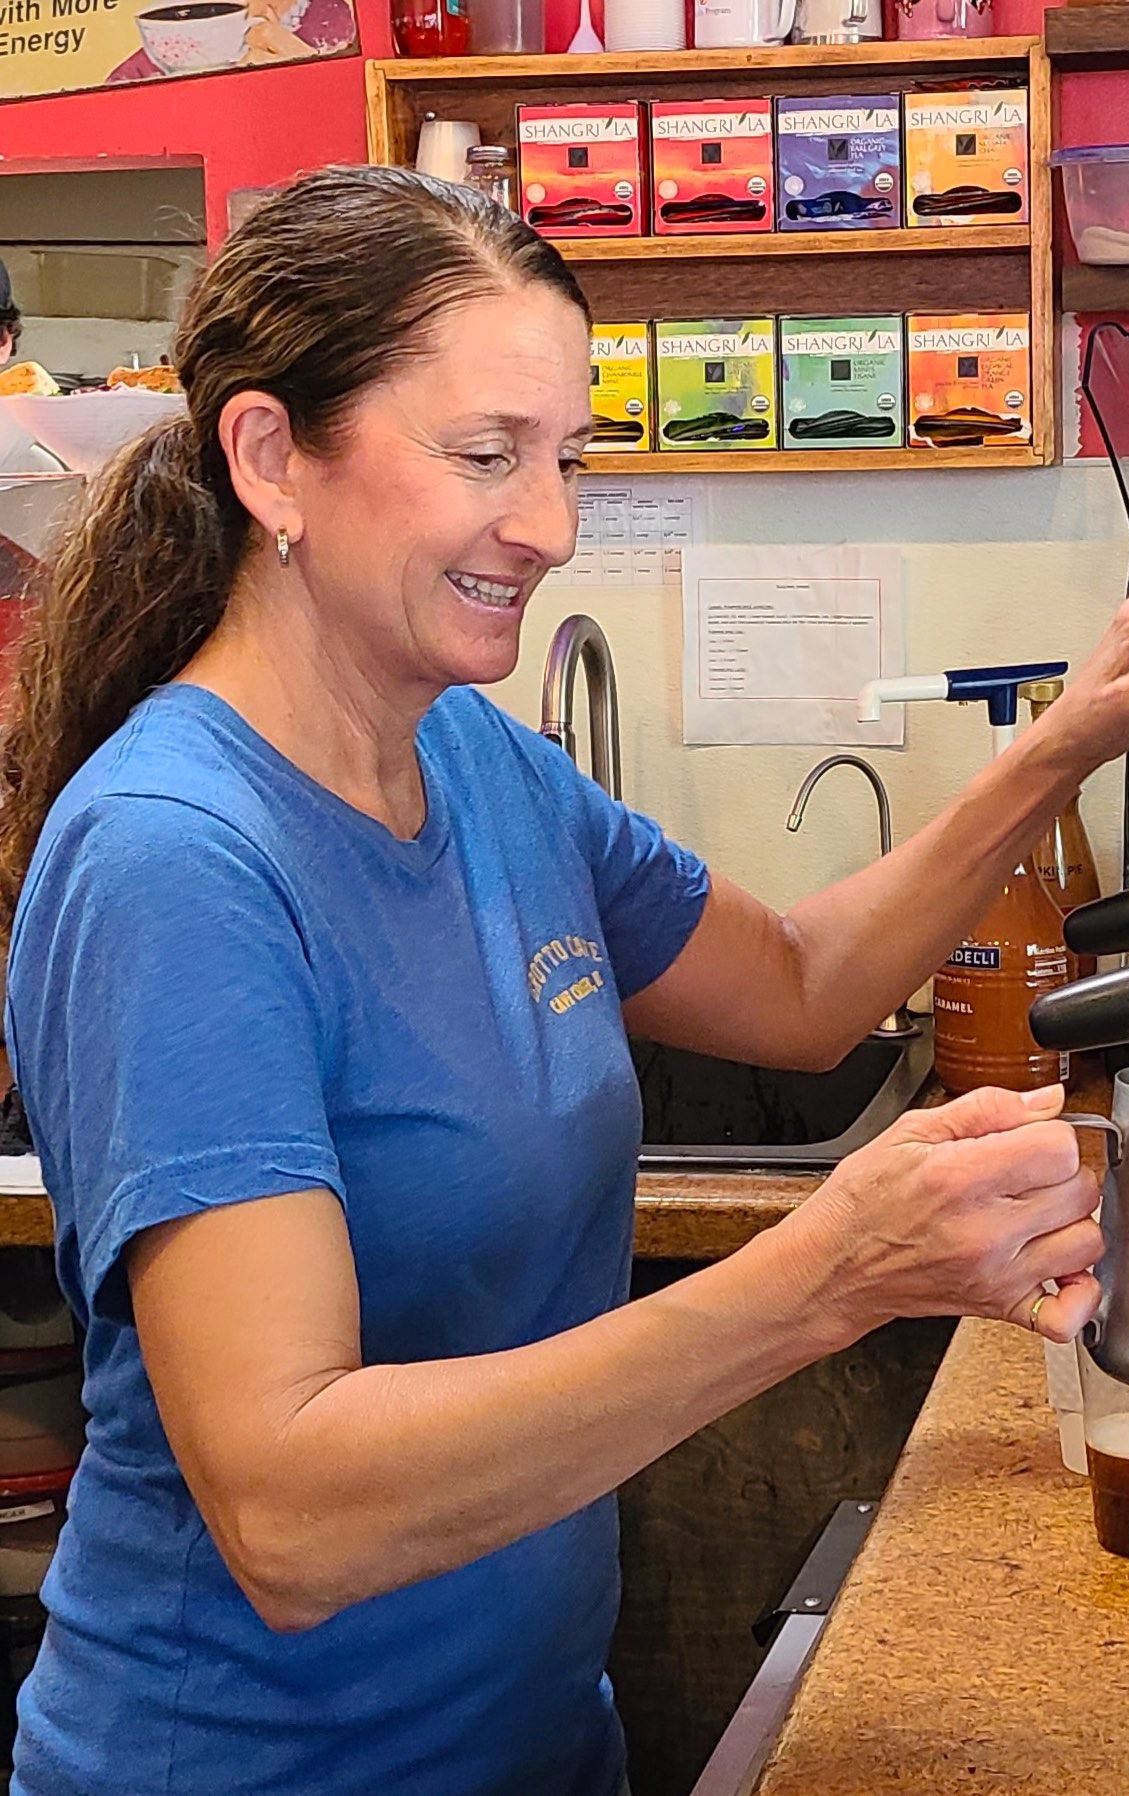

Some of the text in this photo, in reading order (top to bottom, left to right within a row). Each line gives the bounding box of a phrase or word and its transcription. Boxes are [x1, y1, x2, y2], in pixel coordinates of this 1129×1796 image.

[0, 27, 86, 55] Energy
[784, 114, 860, 130] SHANGRI
[911, 109, 988, 126] SHANGRI
[525, 122, 600, 138] SHANGRI
[657, 119, 733, 135] SHANGRI
[661, 338, 736, 353] SHANGRI
[787, 335, 863, 351] SHANGRI
[914, 332, 990, 348] SHANGRI
[934, 996, 974, 1014] CARAMEL
